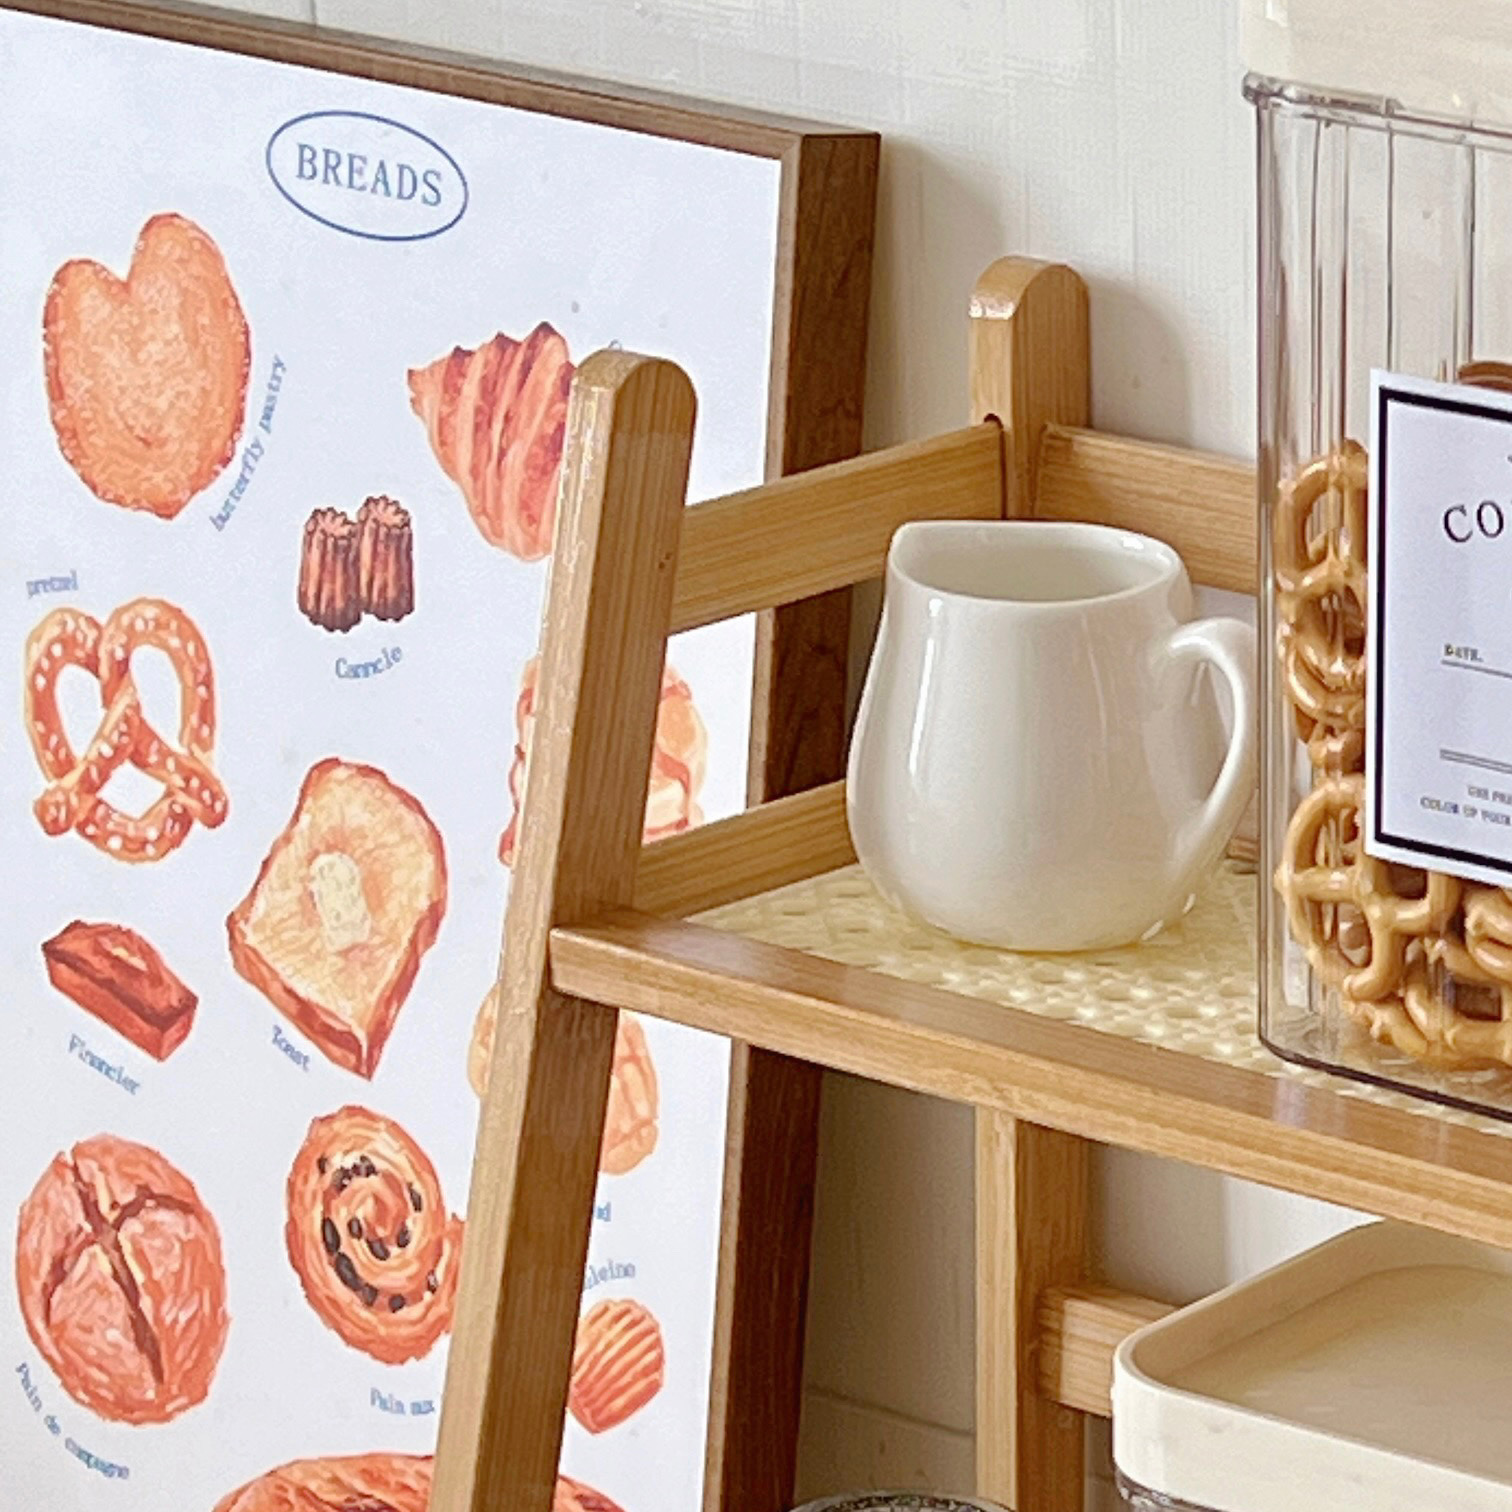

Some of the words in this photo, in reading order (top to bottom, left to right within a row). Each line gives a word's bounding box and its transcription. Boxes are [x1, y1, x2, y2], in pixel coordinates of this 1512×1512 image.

[296, 143, 442, 207] BREADS
[209, 437, 265, 532] butterfly
[259, 354, 287, 434] pastry
[1420, 796, 1460, 814] COLOR
[68, 1033, 140, 1095] Financier
[16, 1361, 42, 1412] Pain
[370, 1387, 406, 1415] Pain
